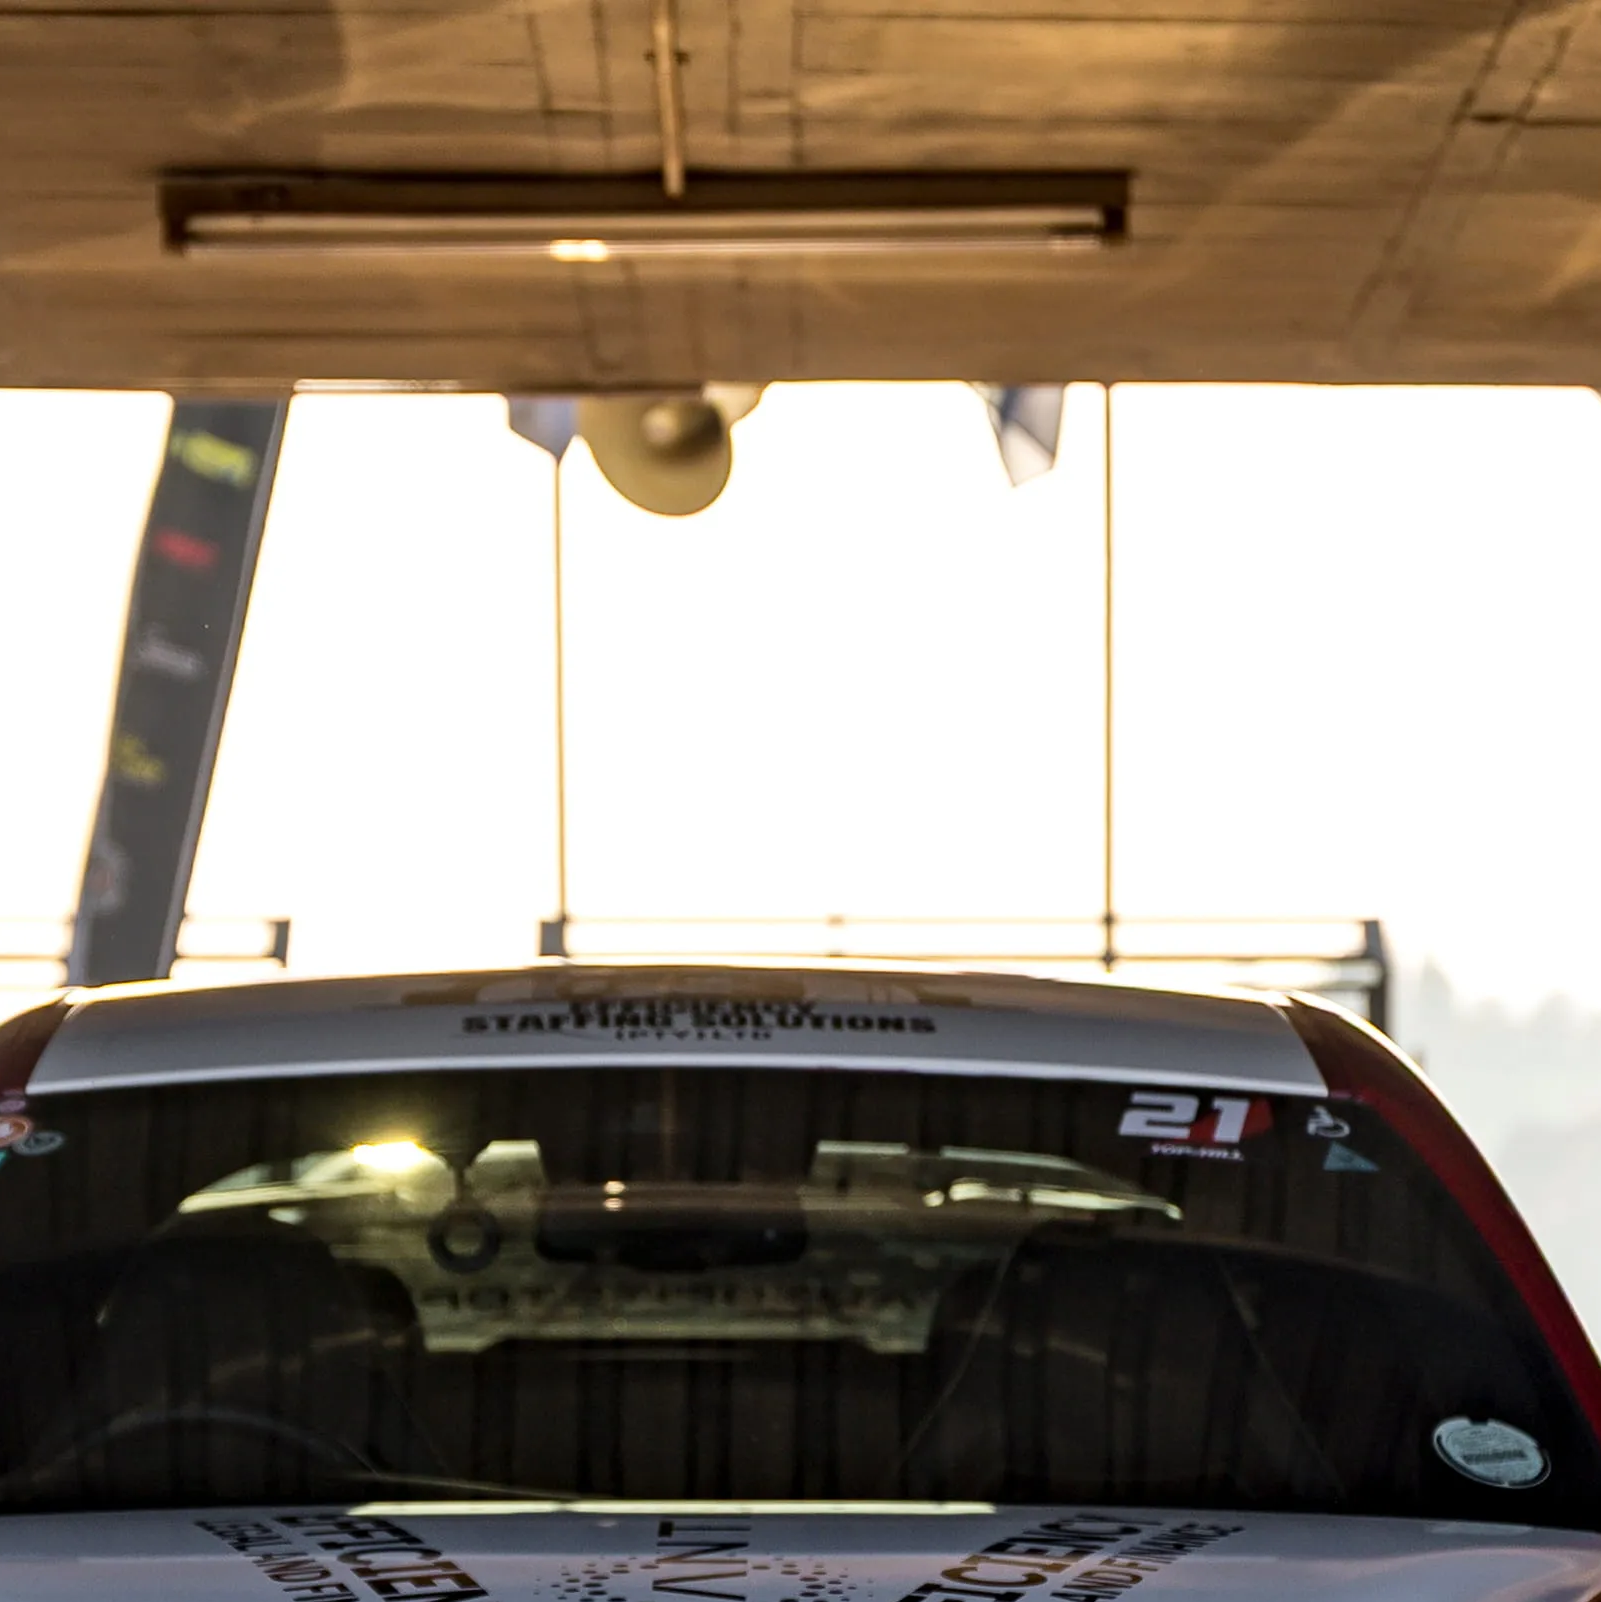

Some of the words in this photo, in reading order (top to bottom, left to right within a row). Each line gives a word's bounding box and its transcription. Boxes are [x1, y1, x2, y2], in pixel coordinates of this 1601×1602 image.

[461, 1011, 674, 1033] STAFFING
[692, 1009, 938, 1034] SOLUTIONS
[1118, 1091, 1250, 1144] 21
[244, 1551, 332, 1583] AND
